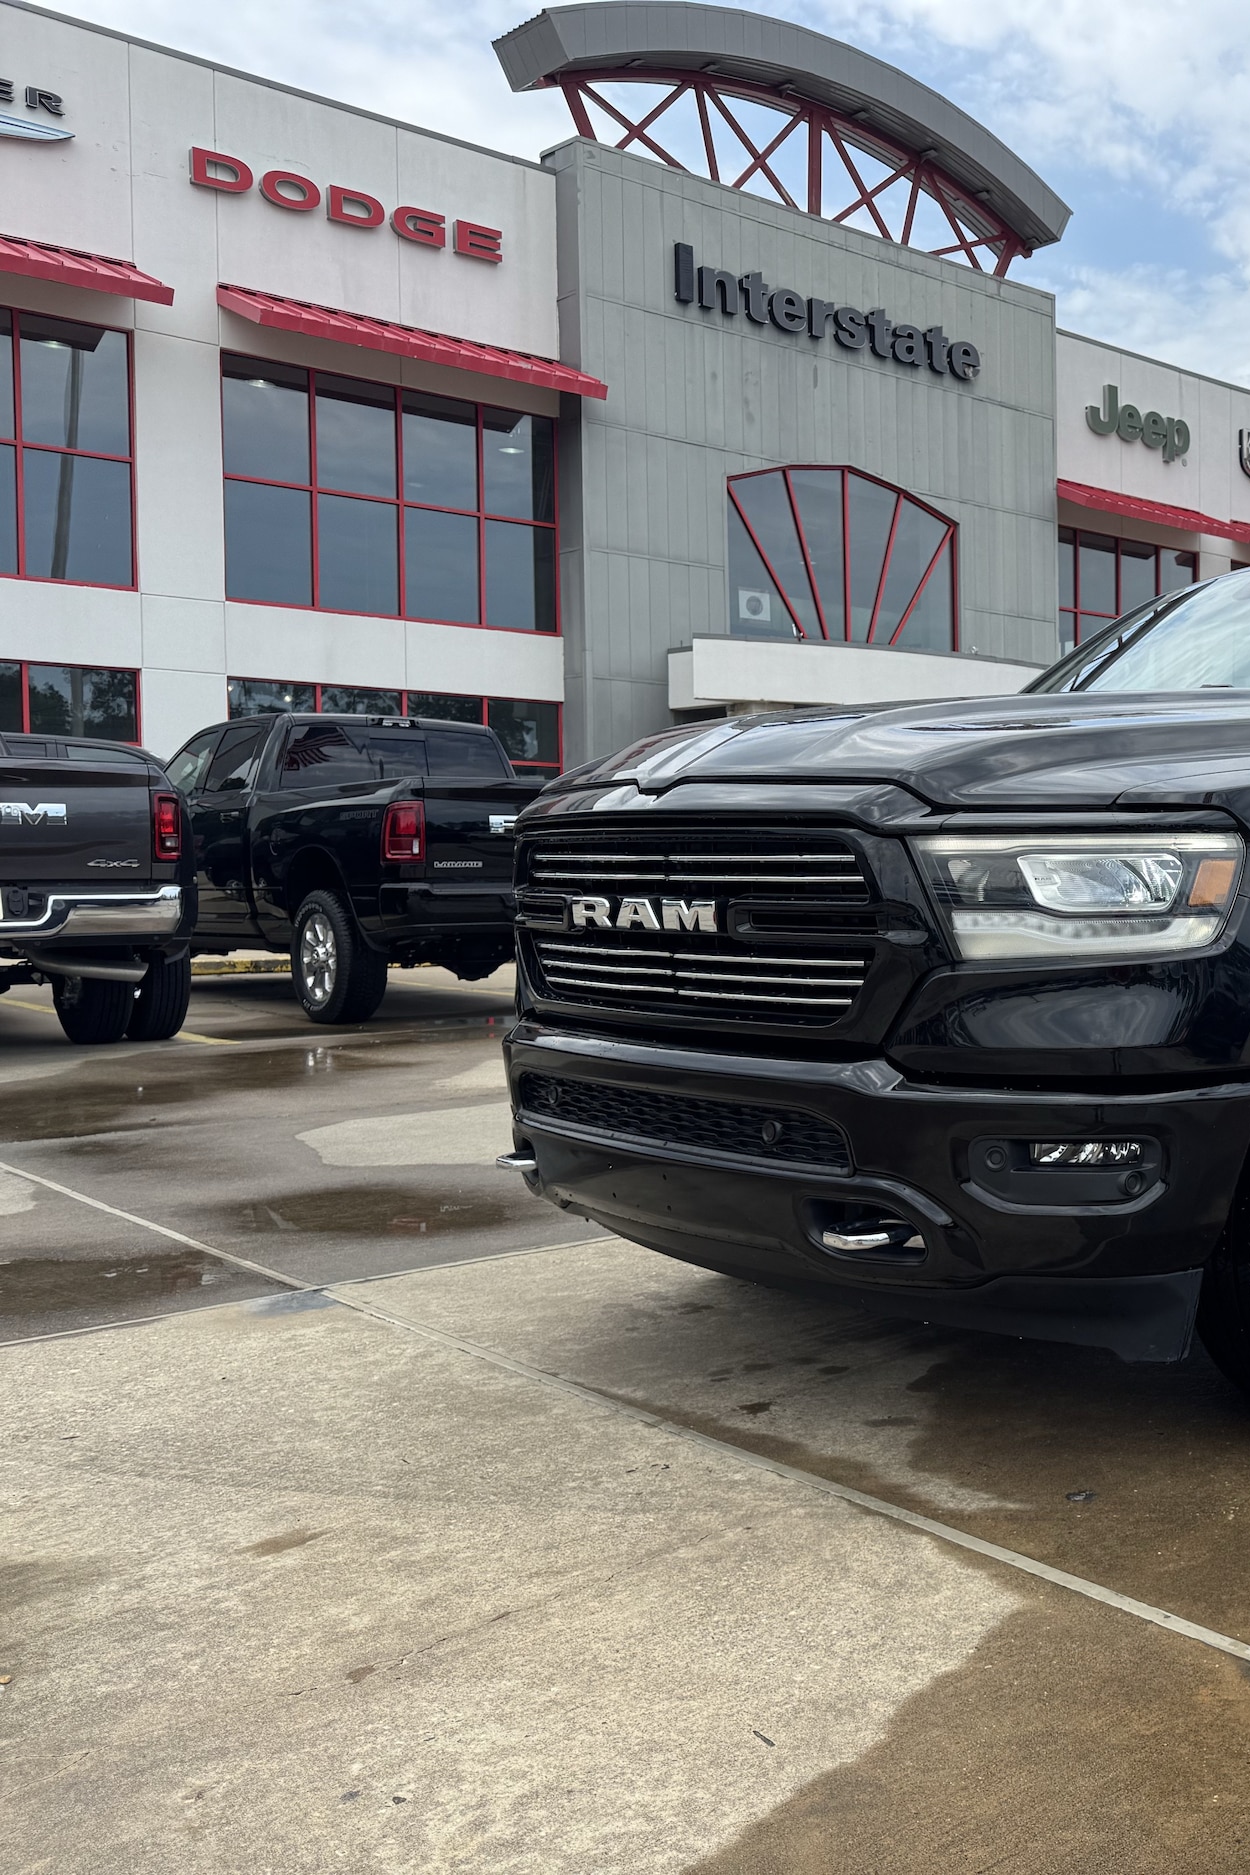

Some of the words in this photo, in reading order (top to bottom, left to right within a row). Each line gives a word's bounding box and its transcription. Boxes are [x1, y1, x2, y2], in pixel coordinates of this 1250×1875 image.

[189, 146, 503, 264] DODGE
[674, 242, 982, 381] Interstate
[1085, 384, 1190, 463] Jeep
[571, 896, 718, 932] RAM
